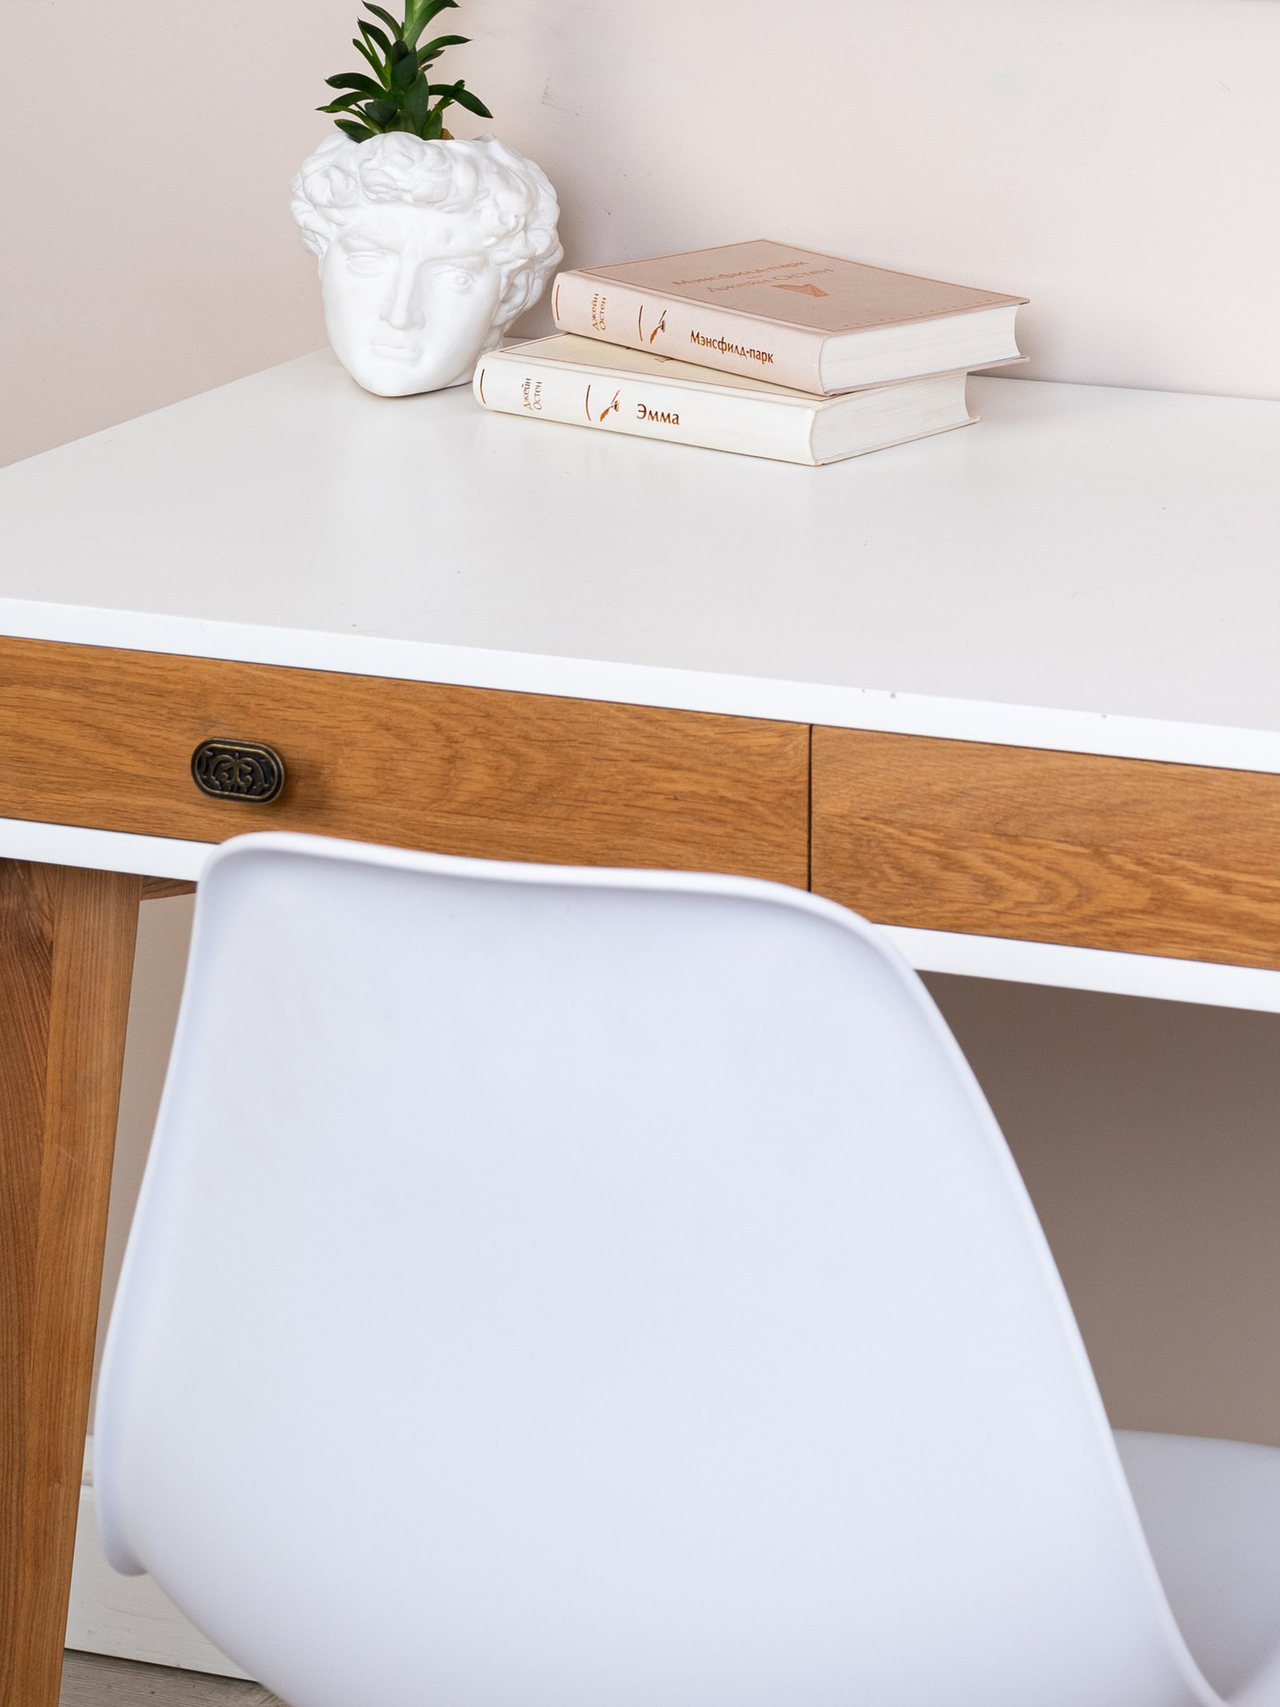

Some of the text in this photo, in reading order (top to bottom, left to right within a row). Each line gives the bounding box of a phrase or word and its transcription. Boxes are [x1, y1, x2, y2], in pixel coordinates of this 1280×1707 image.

[590, 293, 600, 332] Джейн
[599, 297, 607, 331] Остен
[690, 330, 774, 365] Мэнсфилд-парк
[521, 377, 533, 411] Джейн
[533, 381, 543, 411] Остен
[636, 403, 680, 426] Эмма
